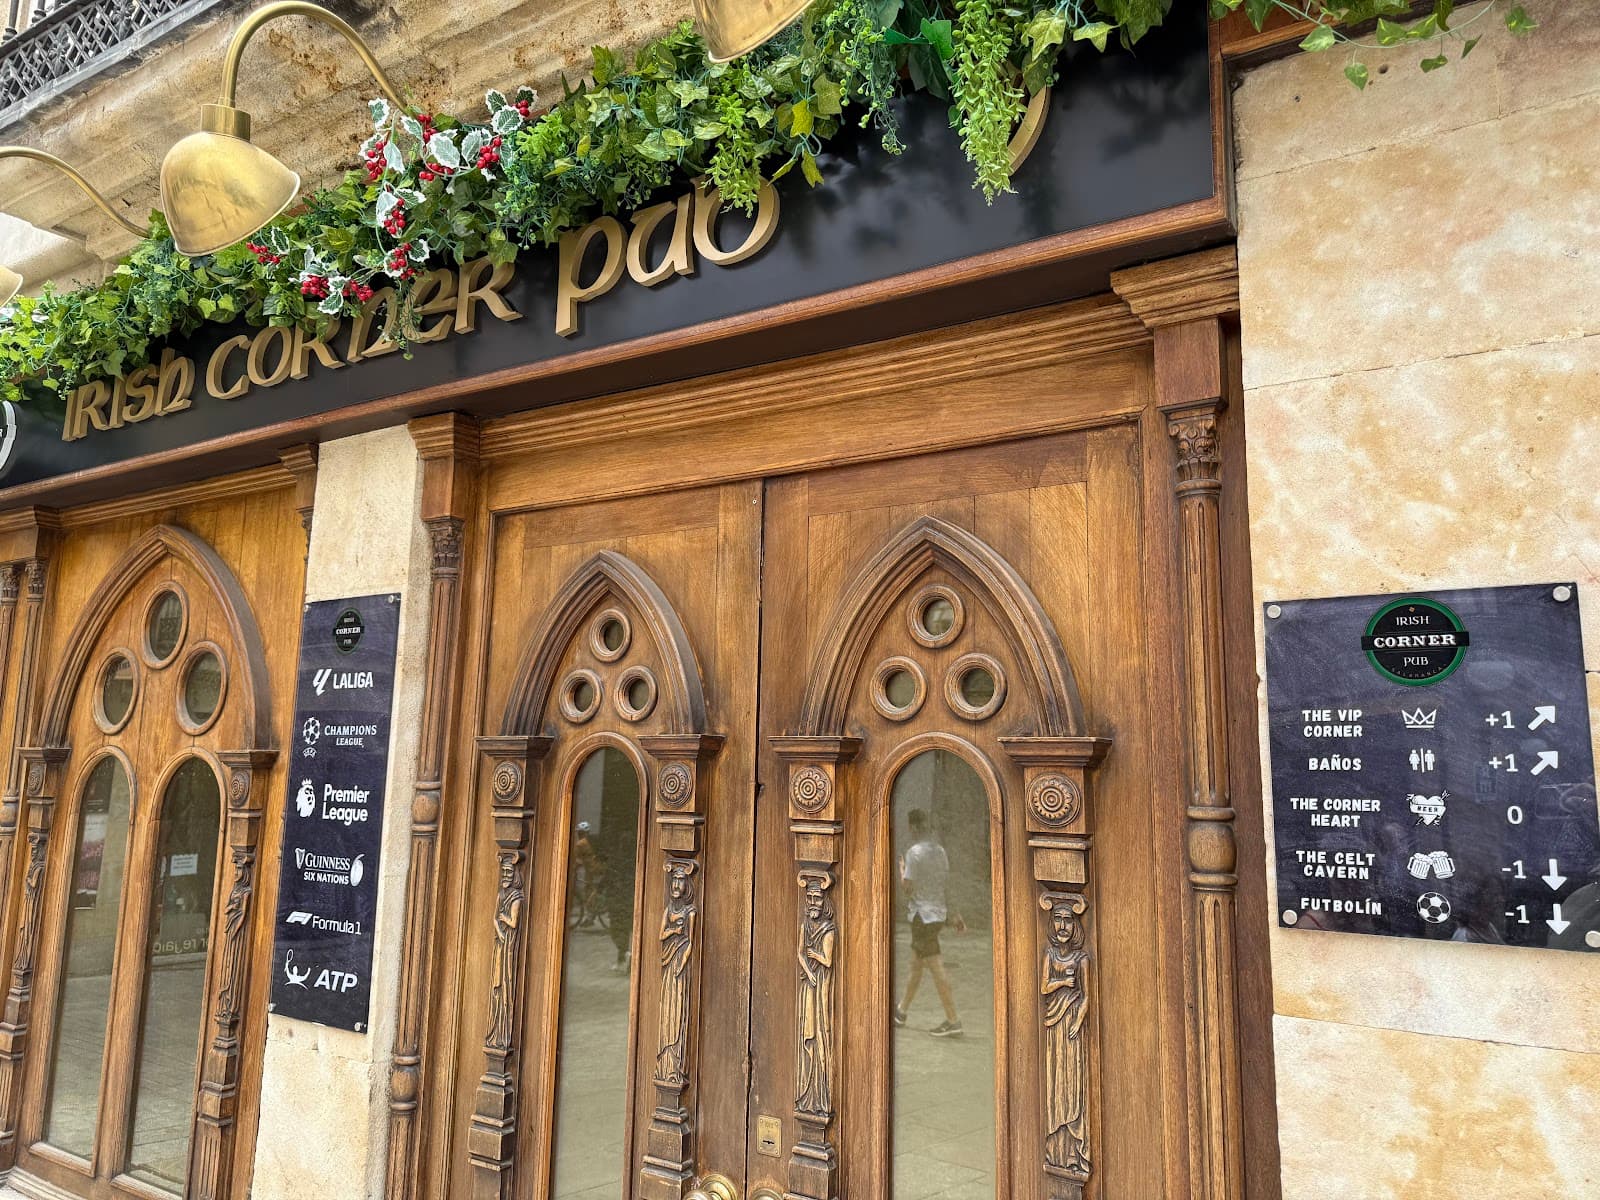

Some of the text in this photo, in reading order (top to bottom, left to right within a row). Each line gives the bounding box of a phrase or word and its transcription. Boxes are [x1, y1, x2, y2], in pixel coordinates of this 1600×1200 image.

[1396, 614, 1430, 626] IRISH
[1373, 633, 1457, 648] CORNER
[1403, 656, 1429, 667] PUB
[333, 672, 373, 689] LALIGA
[1301, 708, 1363, 722] THE VIP
[1485, 710, 1516, 729] +1
[324, 724, 378, 736] CHAMPIONS
[1303, 725, 1363, 738] CORNER
[335, 737, 364, 746] LEAGUE
[1308, 754, 1362, 771] BAÑOS
[1488, 754, 1519, 773] +1
[323, 783, 370, 804] Premier
[1289, 797, 1381, 812] THE CORNER
[322, 802, 369, 826] League
[1311, 813, 1361, 828] HEART
[305, 852, 351, 871] GUINNESS
[1295, 850, 1376, 867] THE CELT
[1303, 864, 1370, 880] CAVERN
[1501, 859, 1527, 879] -1
[303, 871, 349, 885] SIX NATIONS
[1300, 897, 1382, 916] FUTBOLÍN
[1505, 904, 1530, 924] -1
[314, 968, 358, 993] ATP
